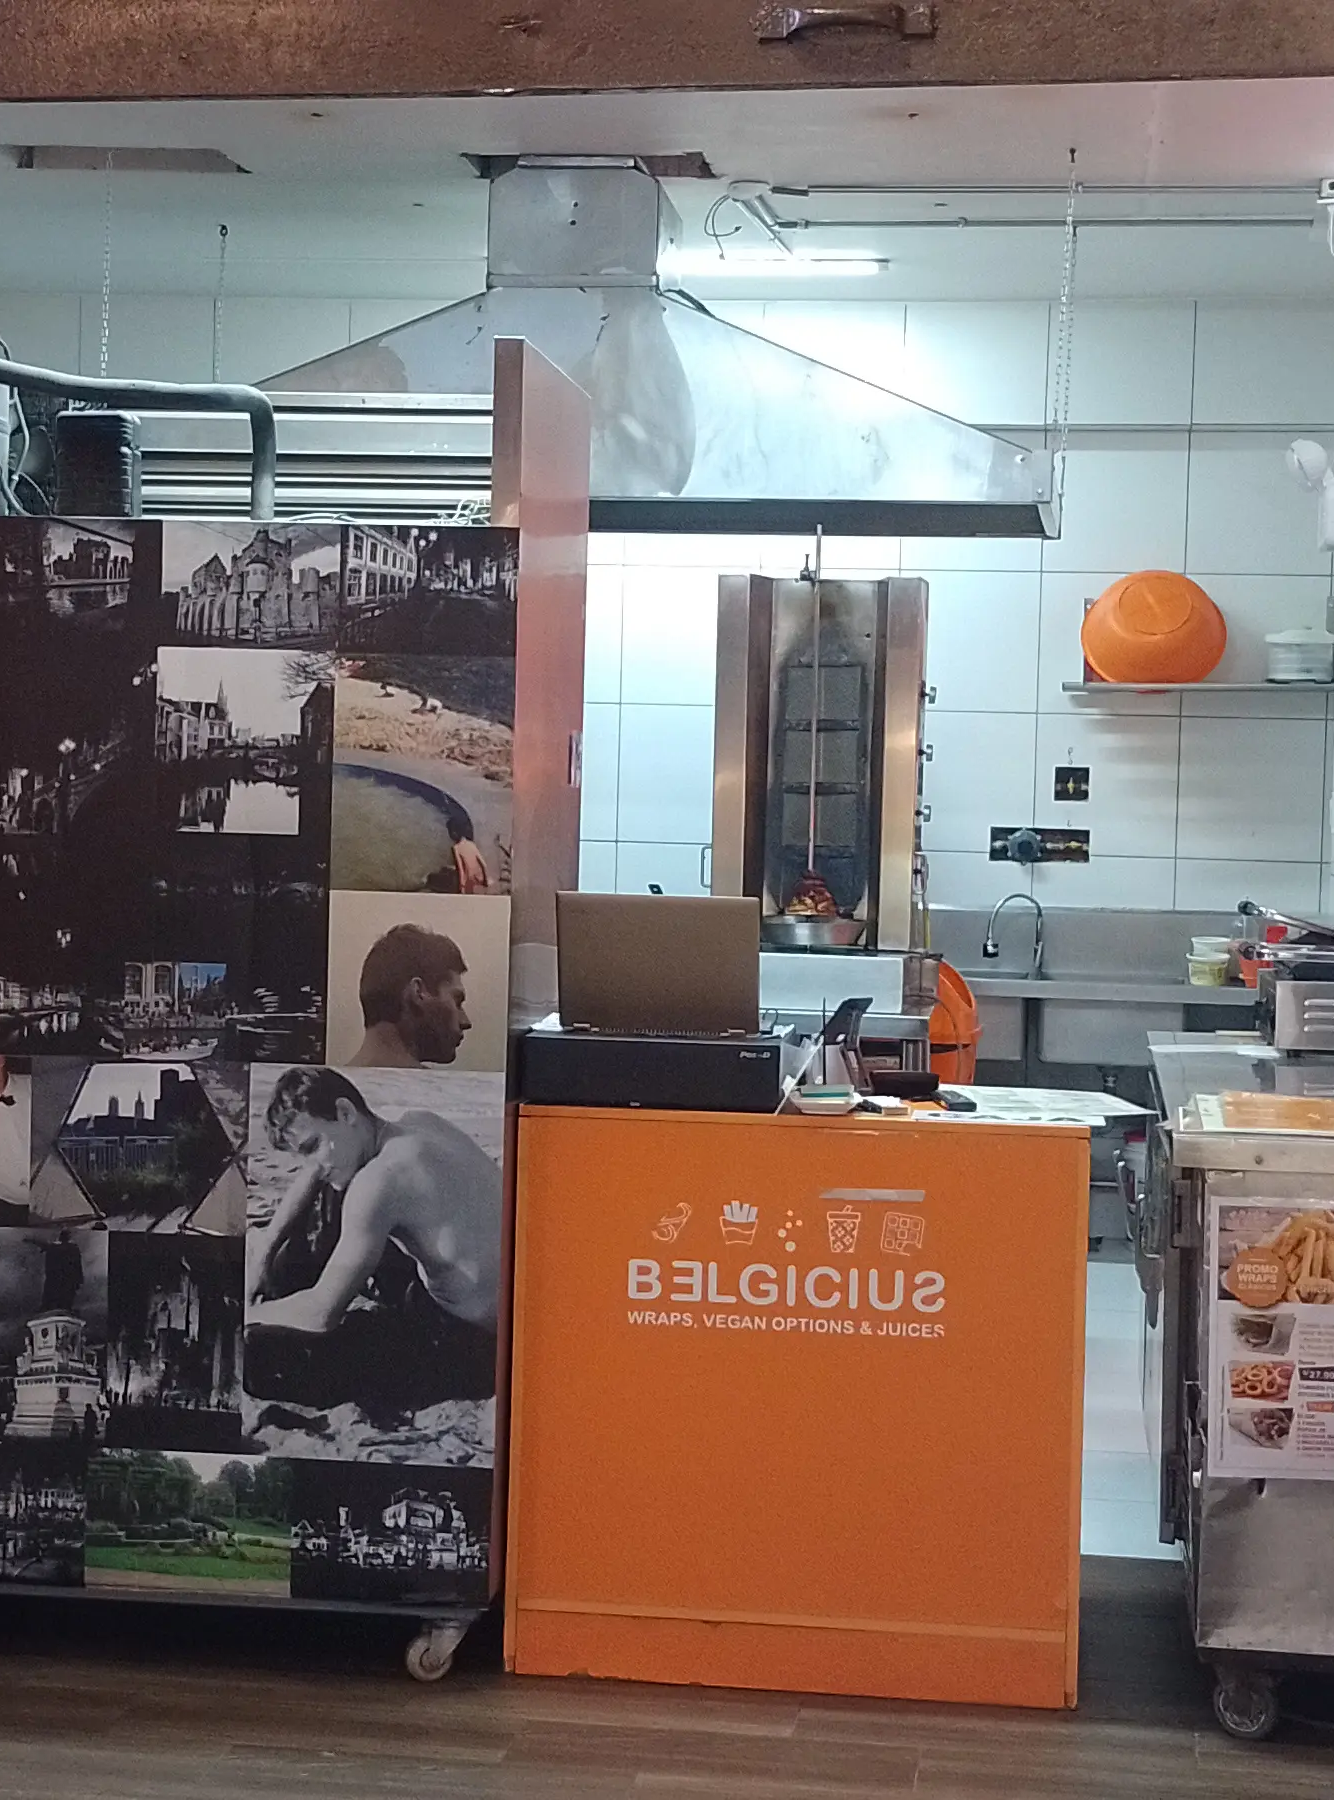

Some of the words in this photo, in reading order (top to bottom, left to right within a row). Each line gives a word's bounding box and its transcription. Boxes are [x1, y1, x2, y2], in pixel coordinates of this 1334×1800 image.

[1236, 1263, 1279, 1274] PROMO
[1237, 1273, 1278, 1284] WRAPS
[627, 1310, 697, 1328] WRAPS,
[703, 1313, 767, 1331] VEGAN
[771, 1315, 854, 1335] OPTIONS
[859, 1320, 873, 1335] &
[877, 1321, 945, 1338] JUICES
